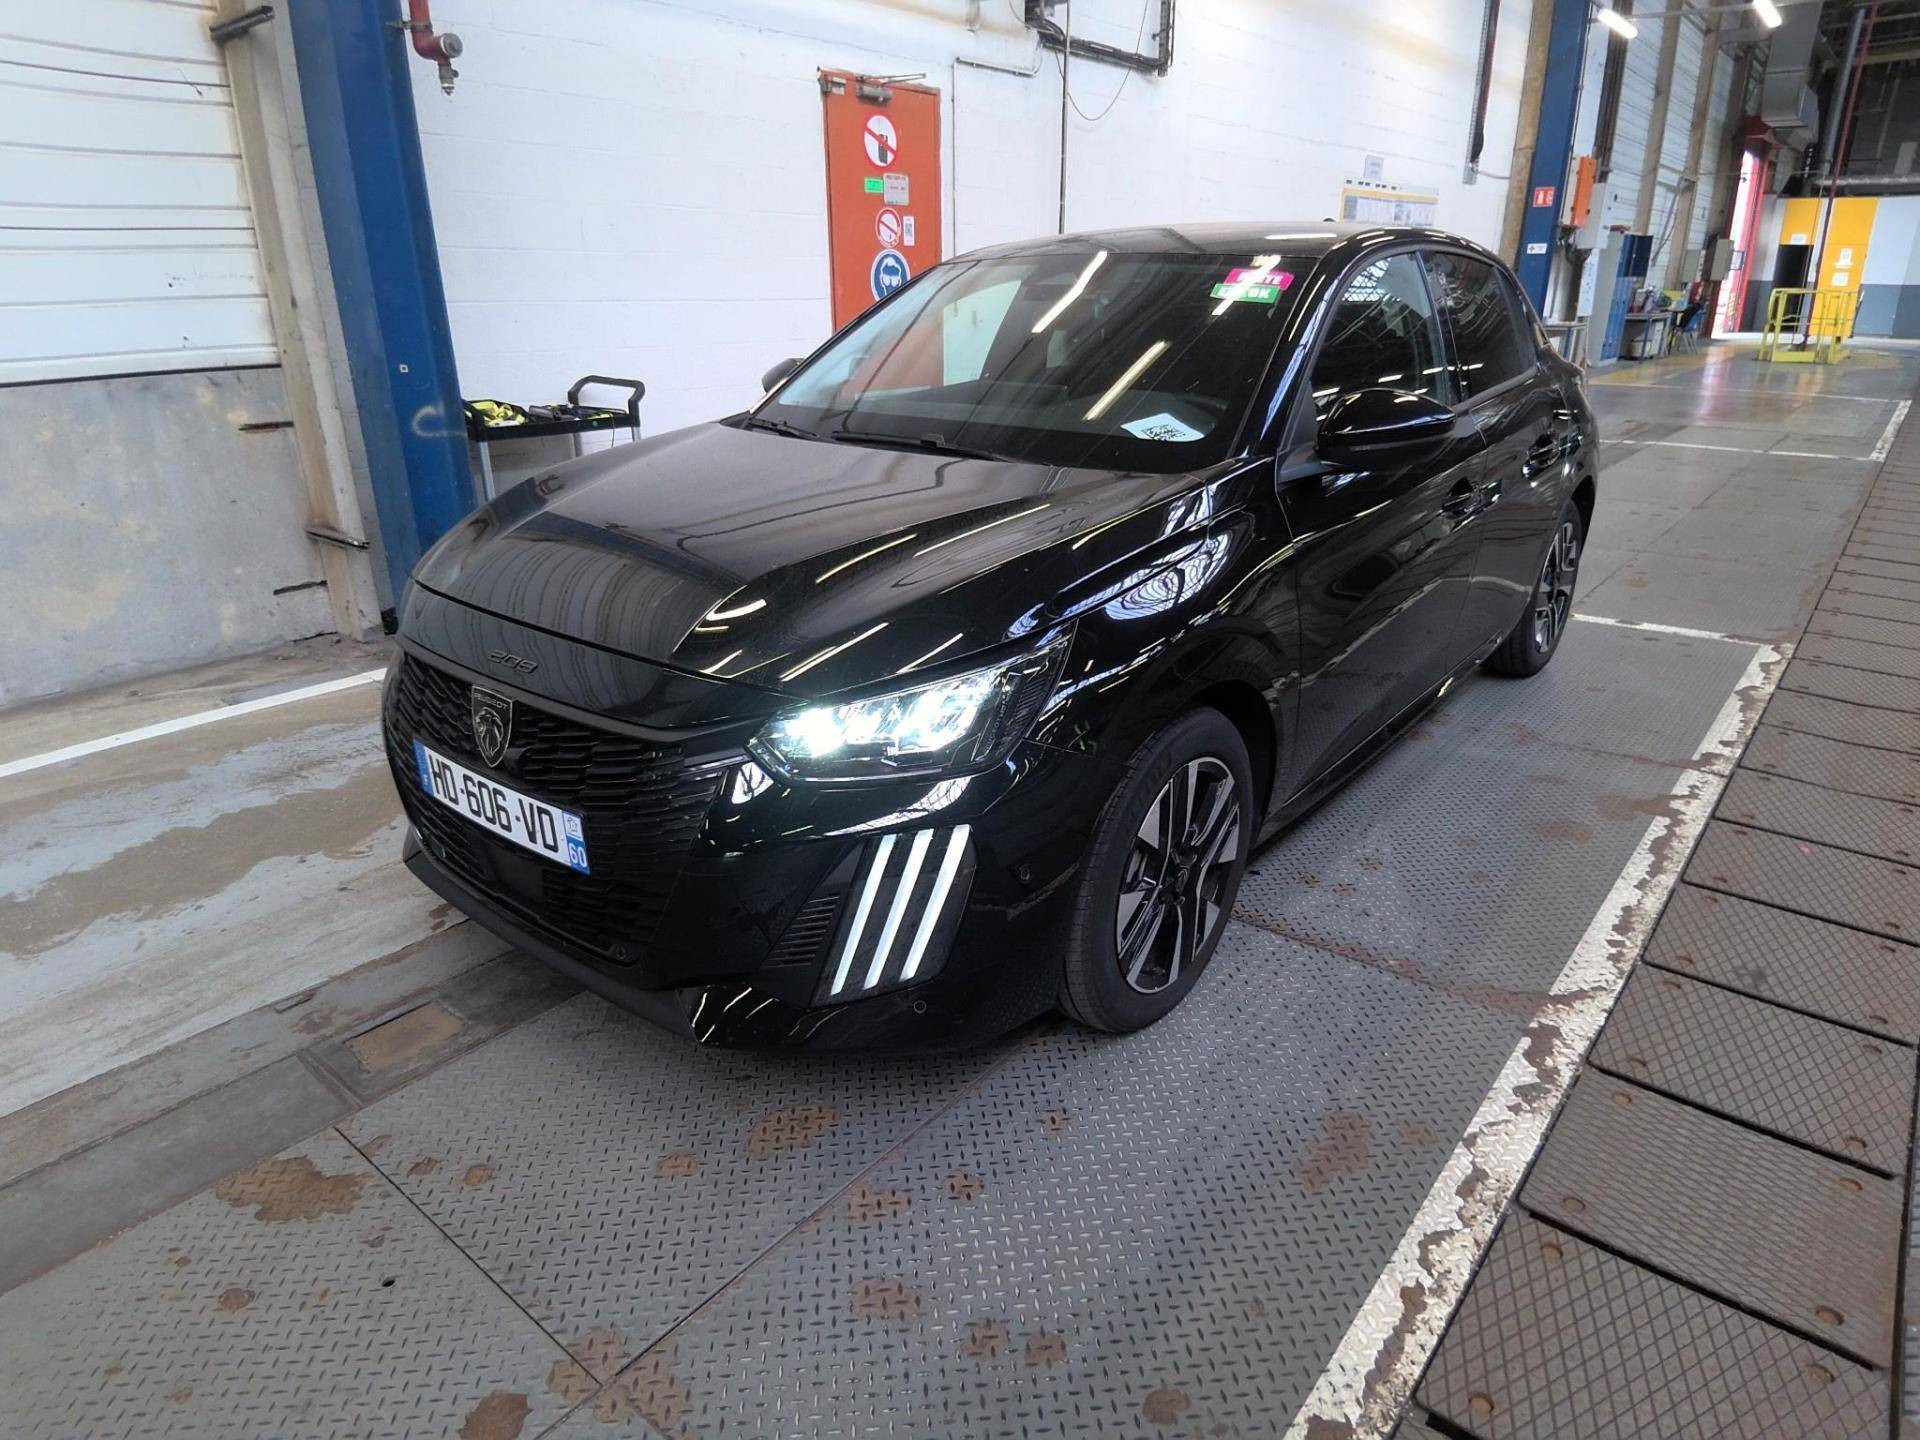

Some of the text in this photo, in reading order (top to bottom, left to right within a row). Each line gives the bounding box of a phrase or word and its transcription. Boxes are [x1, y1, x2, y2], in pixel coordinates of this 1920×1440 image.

[488, 649, 538, 673] 208
[428, 753, 559, 853] HD-606-VD
[569, 842, 587, 868] 60
